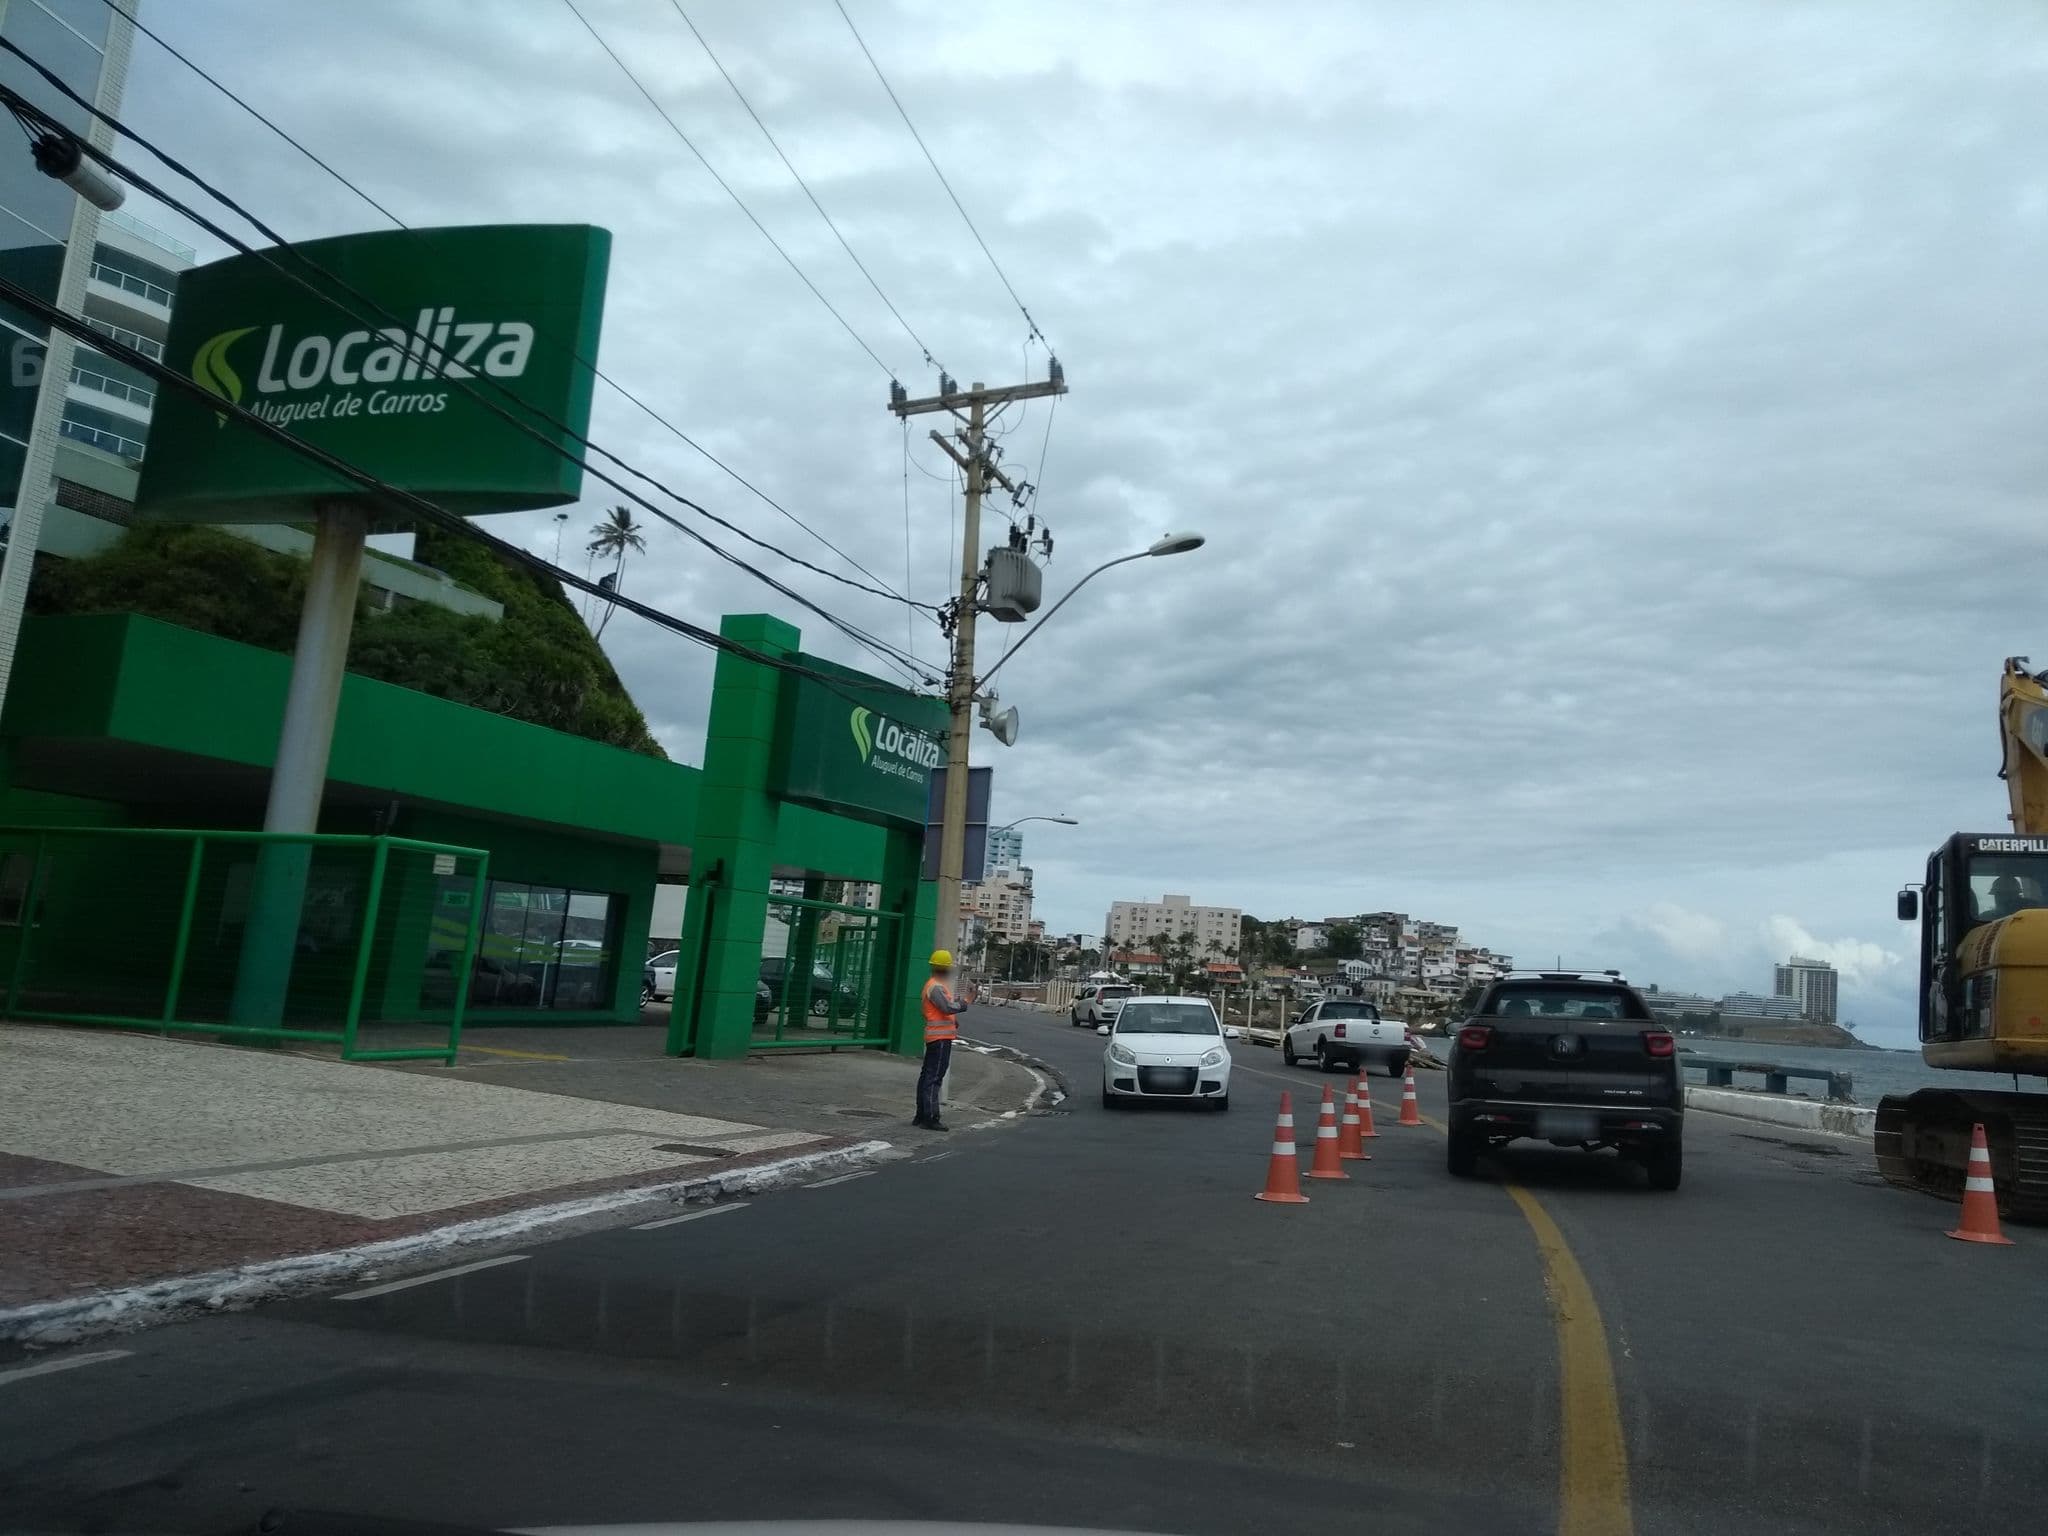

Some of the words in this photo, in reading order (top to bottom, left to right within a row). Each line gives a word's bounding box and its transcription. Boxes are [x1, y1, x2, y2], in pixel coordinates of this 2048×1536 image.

[257, 307, 535, 393] Localiza
[250, 394, 330, 428] Aluguel
[332, 392, 363, 417] de
[368, 390, 449, 415] Carros
[875, 712, 940, 769] Localiza
[871, 754, 898, 775] Aluguel
[898, 762, 906, 778] de
[906, 766, 924, 784] Carros
[1979, 839, 2048, 852] CATERPILL
